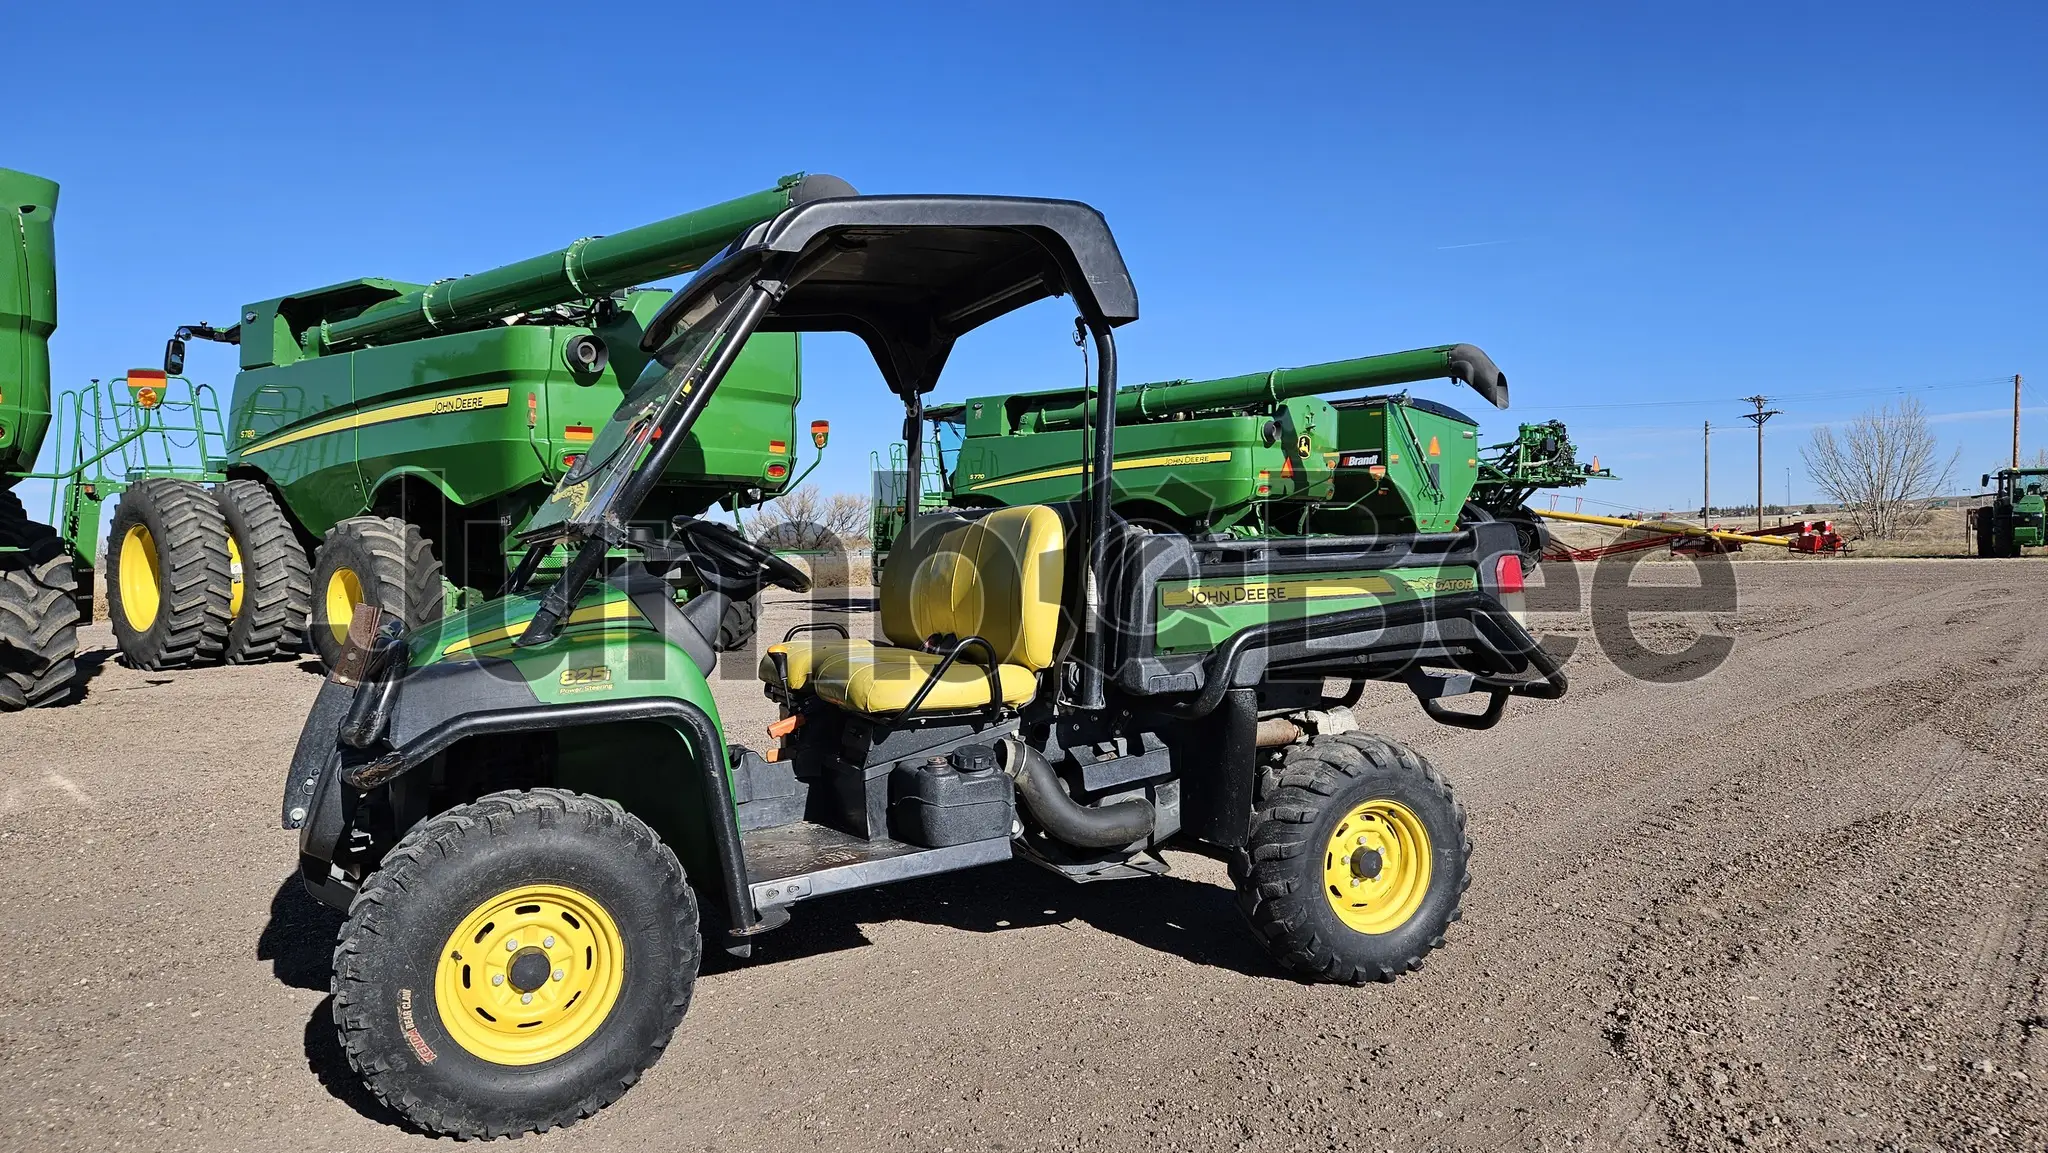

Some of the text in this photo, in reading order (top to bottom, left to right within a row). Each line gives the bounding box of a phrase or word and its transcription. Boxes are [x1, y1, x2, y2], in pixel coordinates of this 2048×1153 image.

[432, 397, 483, 413] JOHN DEERE
[1164, 455, 1210, 465] JOHN DEERE
[1348, 454, 1379, 466] Brandt
[1434, 578, 1474, 591] GATOR
[1186, 586, 1286, 604] JOHN DEERE
[560, 665, 612, 686] 825i
[559, 683, 613, 695] Power Steering
[401, 988, 437, 1062] KENDA BEAR CLAW
